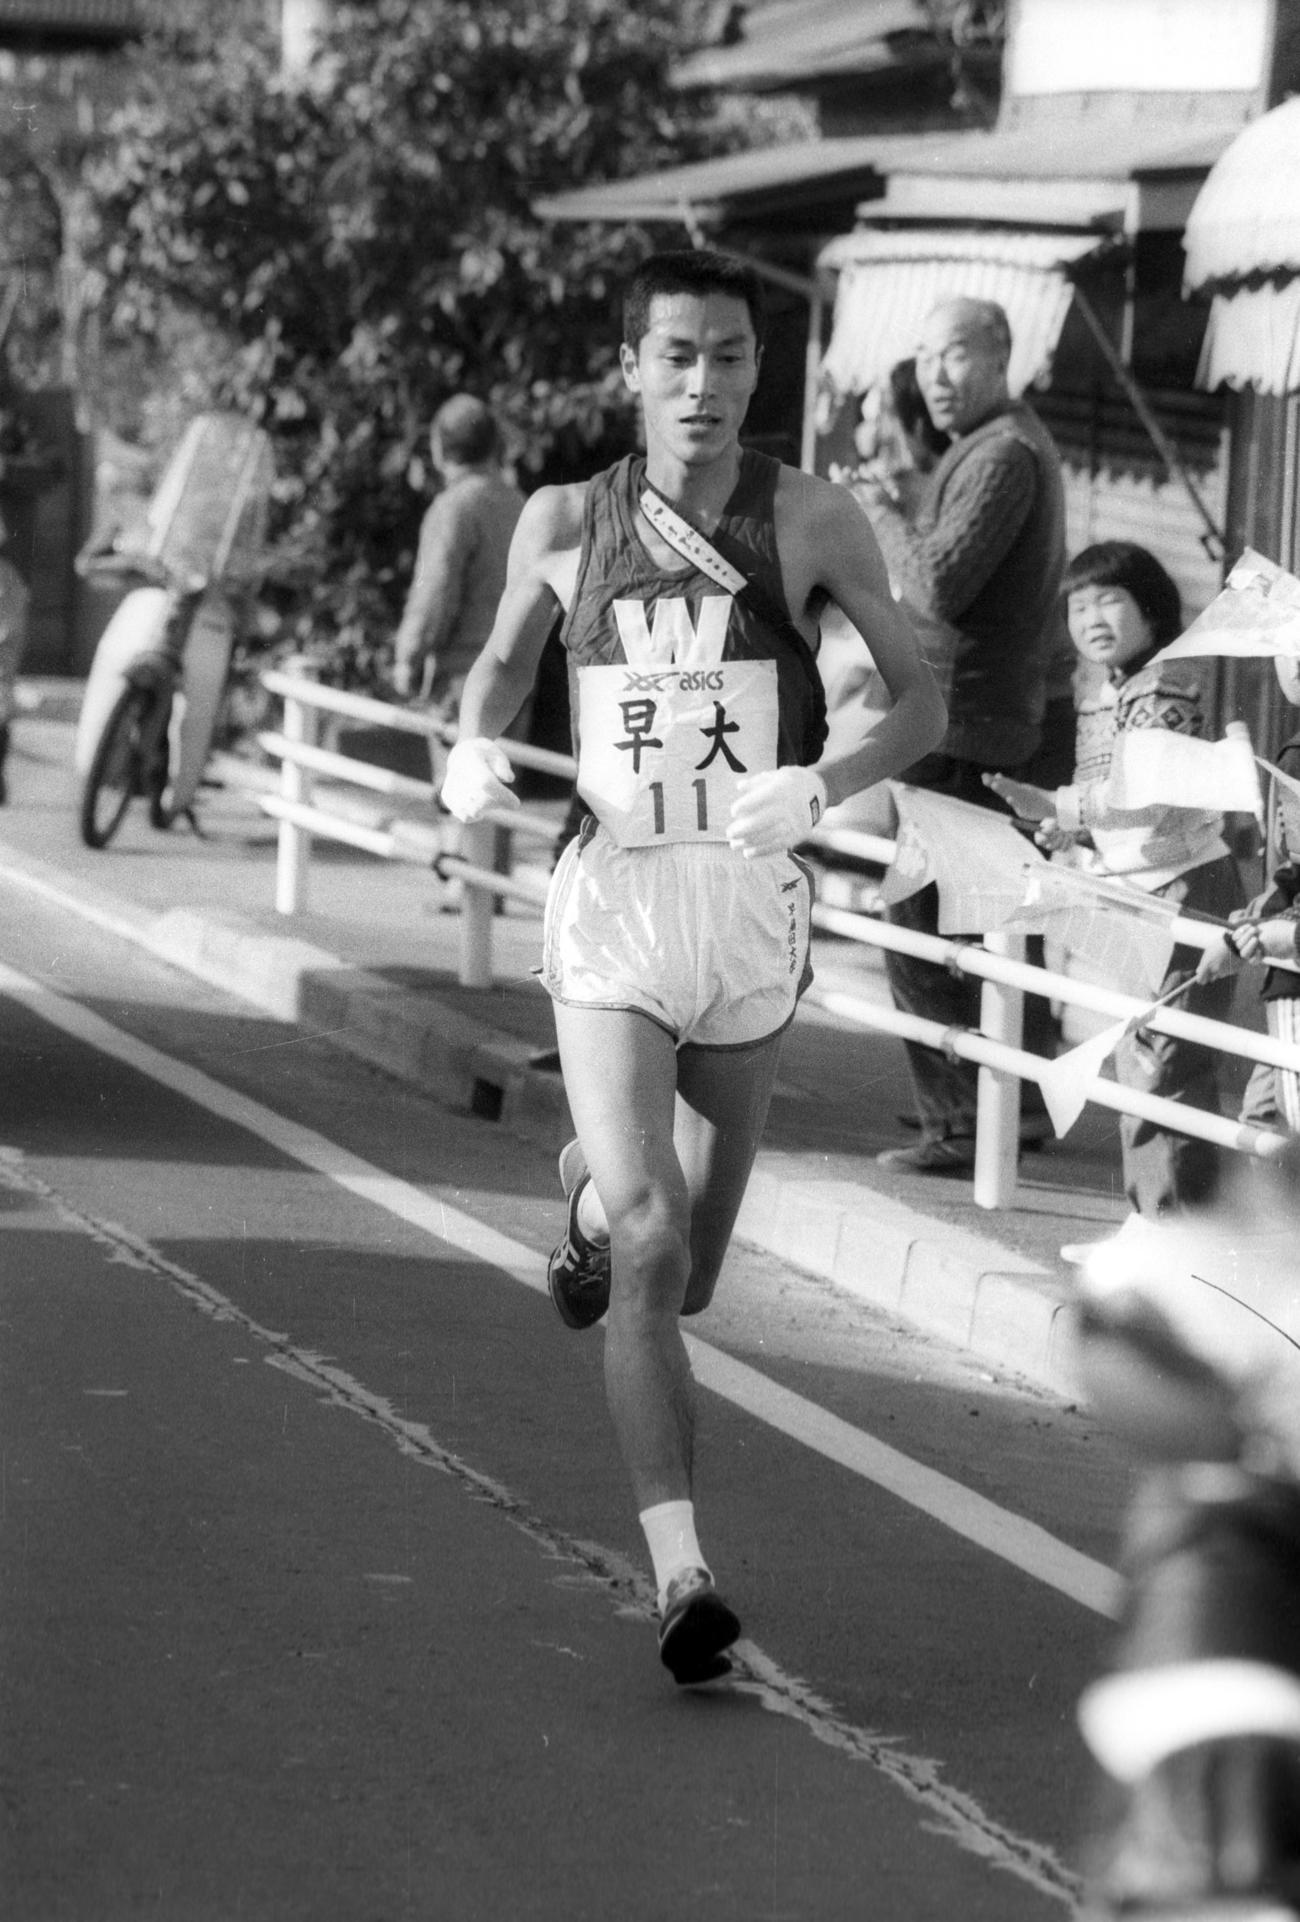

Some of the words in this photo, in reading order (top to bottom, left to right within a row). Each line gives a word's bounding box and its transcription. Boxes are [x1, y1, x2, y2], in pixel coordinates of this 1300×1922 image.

[679, 670, 724, 691] asics
[612, 698, 748, 775] 早大
[648, 778, 708, 835] 11
